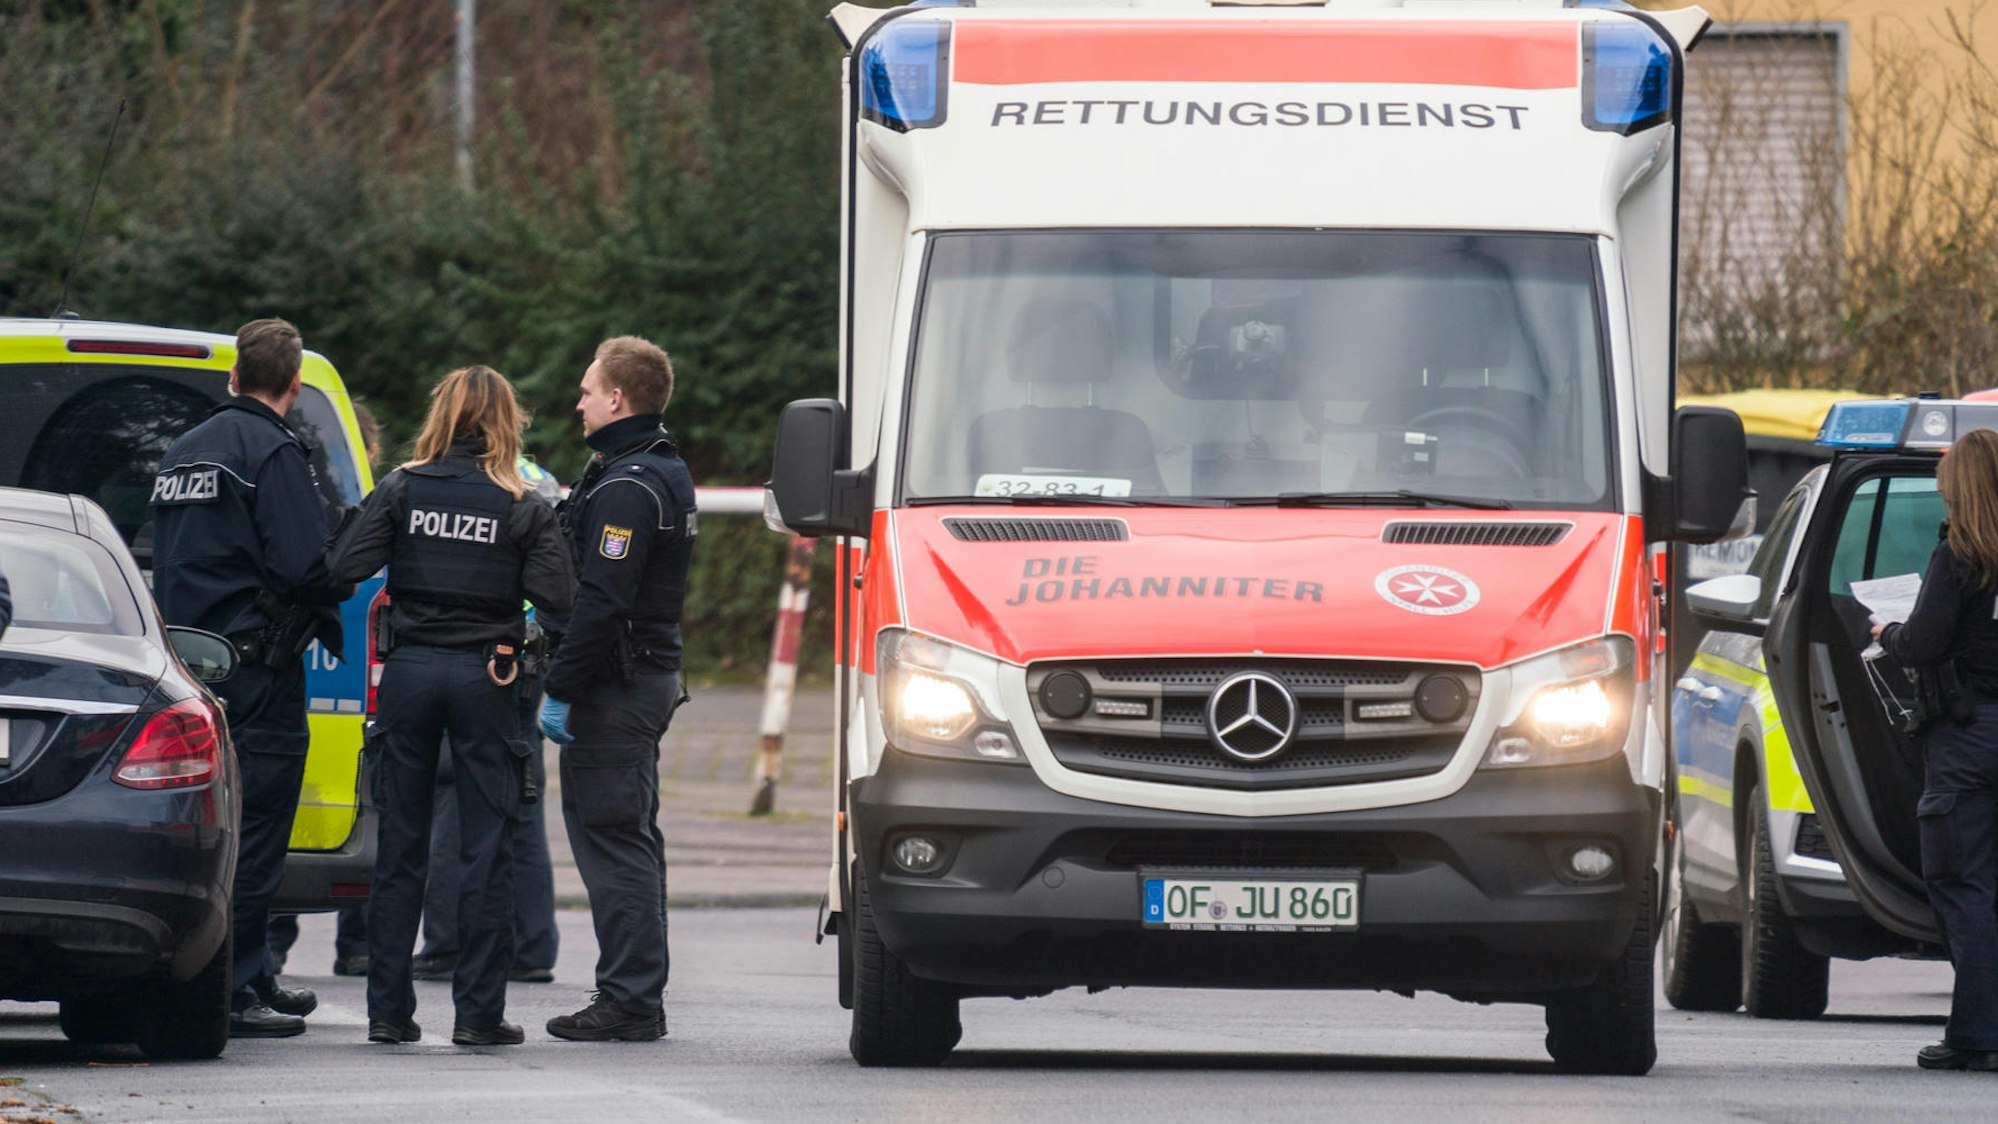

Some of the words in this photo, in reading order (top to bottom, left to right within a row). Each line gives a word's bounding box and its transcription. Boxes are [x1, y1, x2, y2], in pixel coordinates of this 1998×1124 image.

[991, 100, 1529, 130] RETTUNGSDIENST
[150, 470, 218, 502] POLIZEI
[409, 509, 498, 544] POLIZEI
[1022, 555, 1098, 578] DIE
[1005, 576, 1325, 607] JOHANNITER
[1167, 885, 1211, 918] OF
[1236, 886, 1280, 919] JU
[1289, 887, 1353, 920] 860
